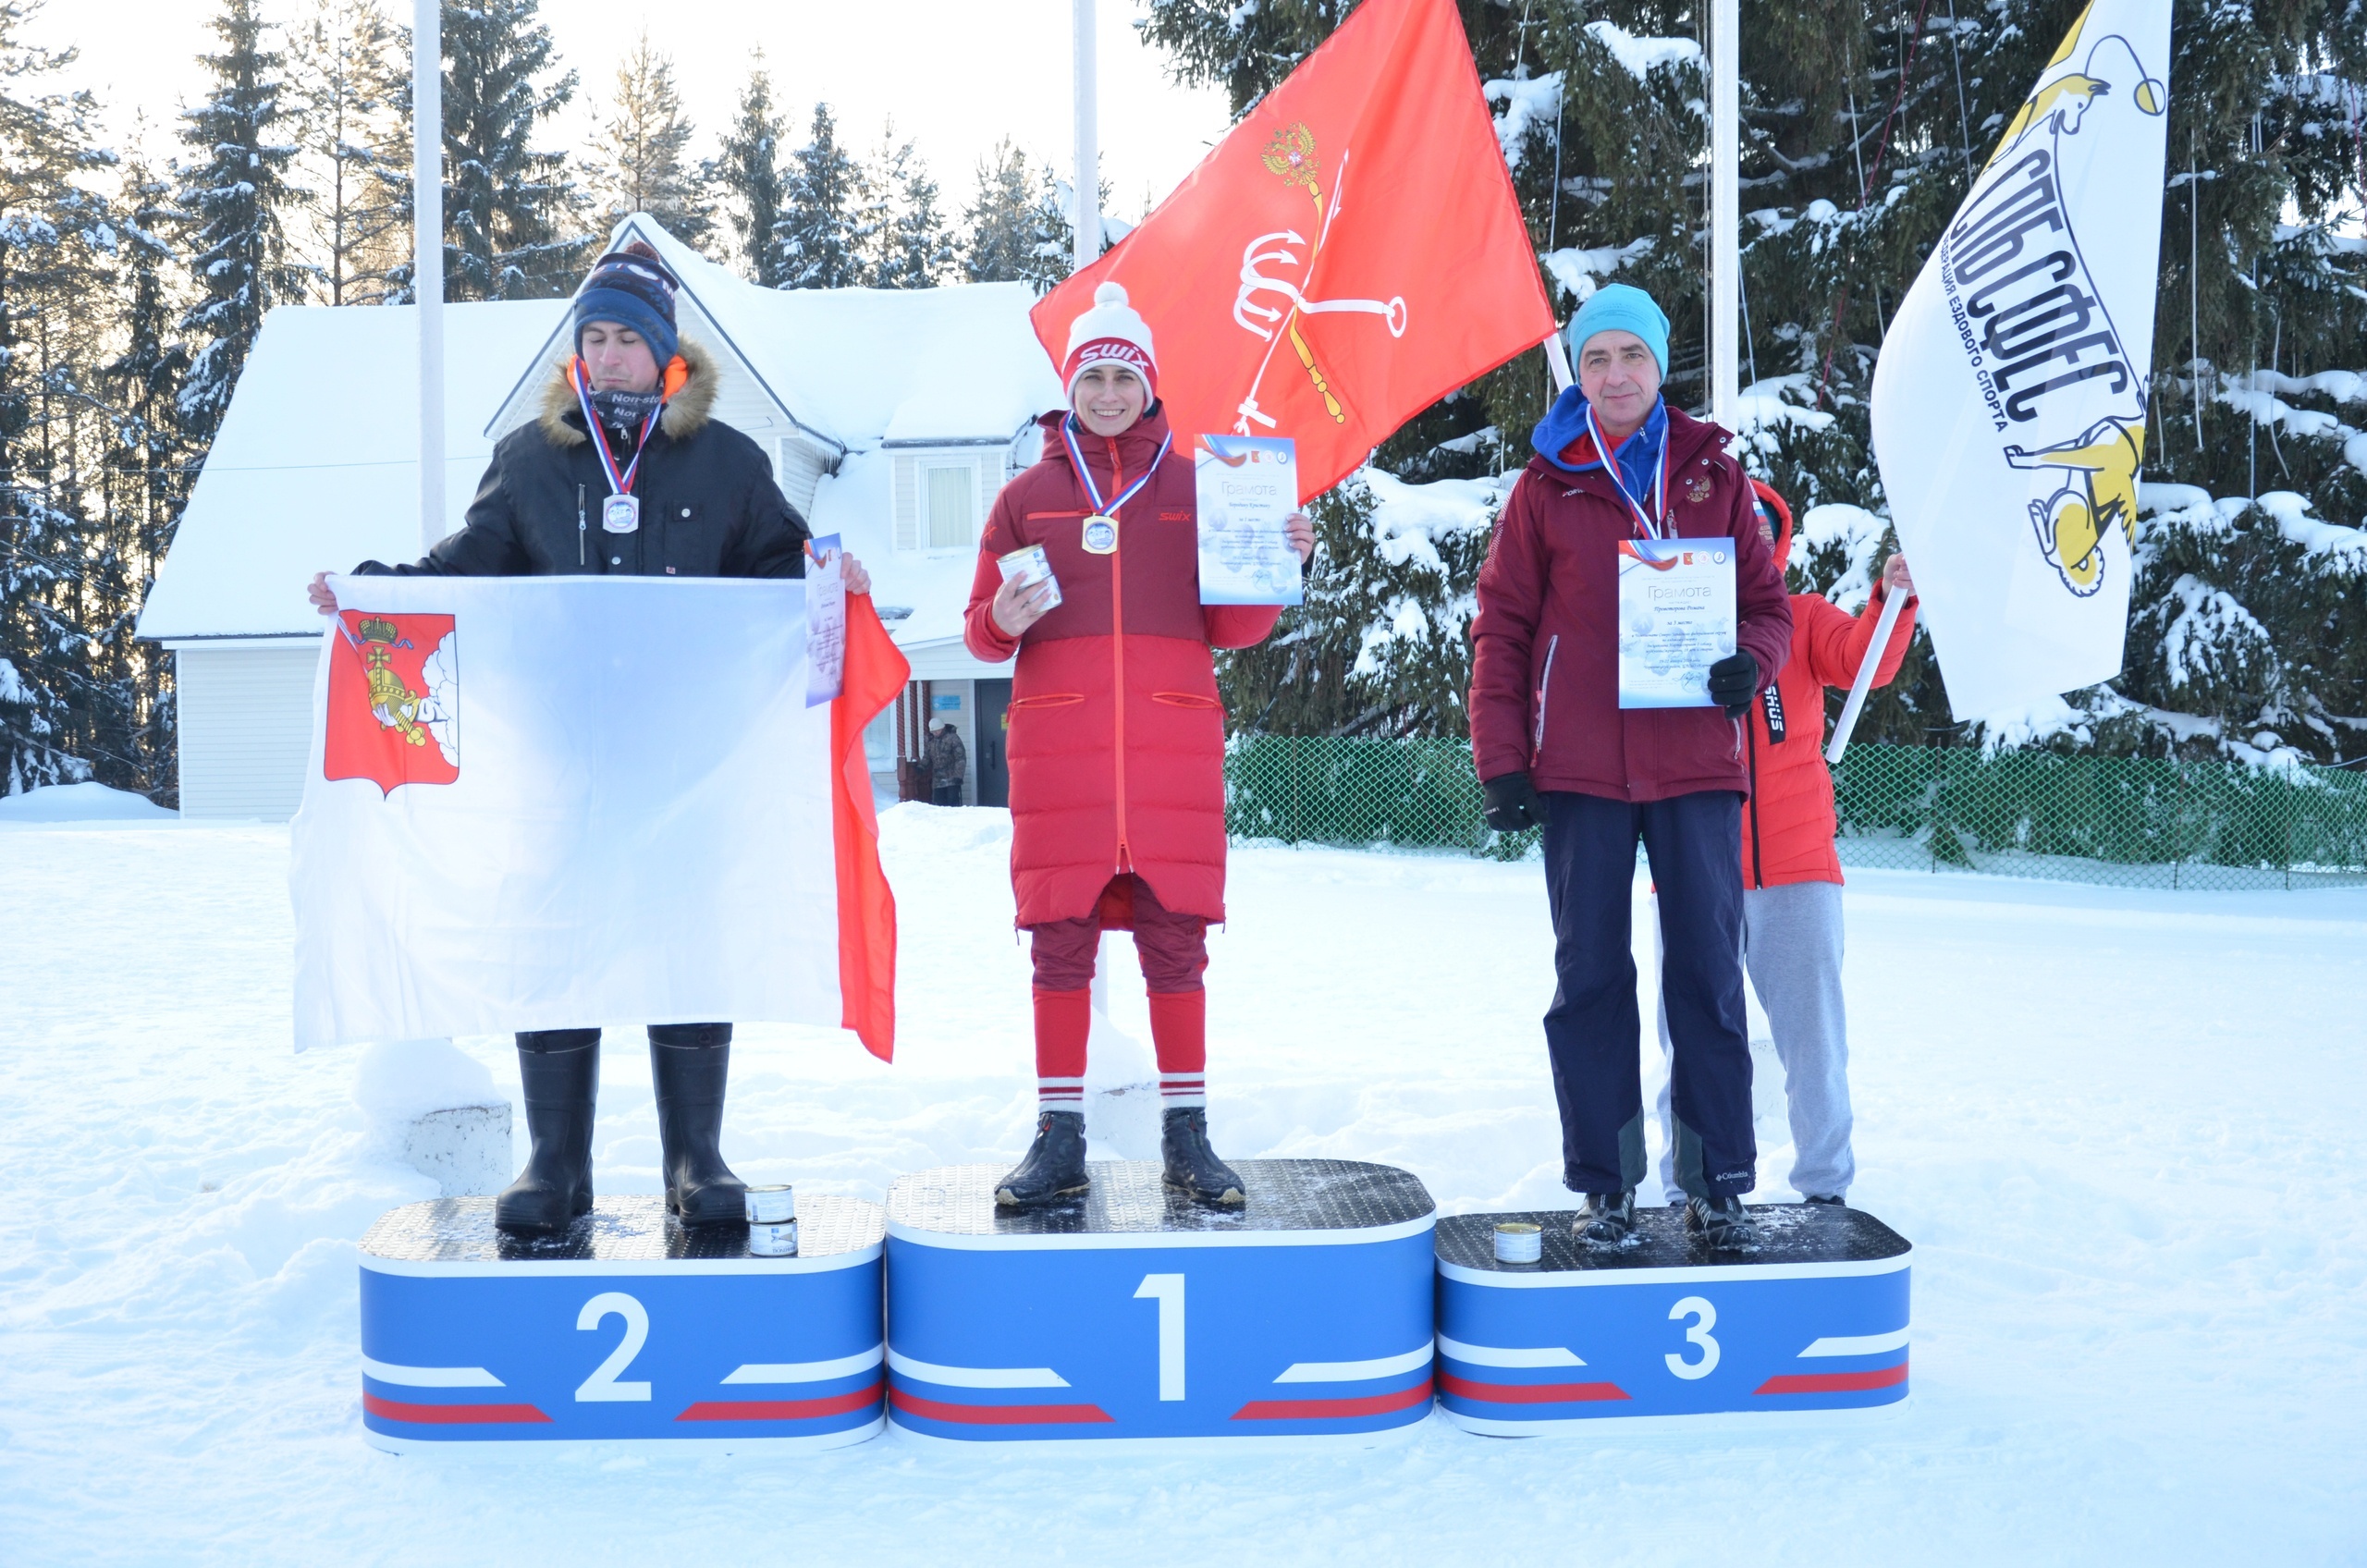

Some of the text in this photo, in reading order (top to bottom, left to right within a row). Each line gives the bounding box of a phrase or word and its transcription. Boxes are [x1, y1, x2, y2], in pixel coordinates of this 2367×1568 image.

[612, 394, 663, 404] Non-sto
[1948, 295, 1983, 367] ЕЗДОВОГО
[1976, 369, 2009, 433] СПОРТА
[1221, 481, 1277, 497] Грамота
[1648, 585, 1712, 601] Грамота
[575, 1292, 651, 1402] 2
[1134, 1274, 1184, 1401] 1
[1665, 1297, 1720, 1379] 3
